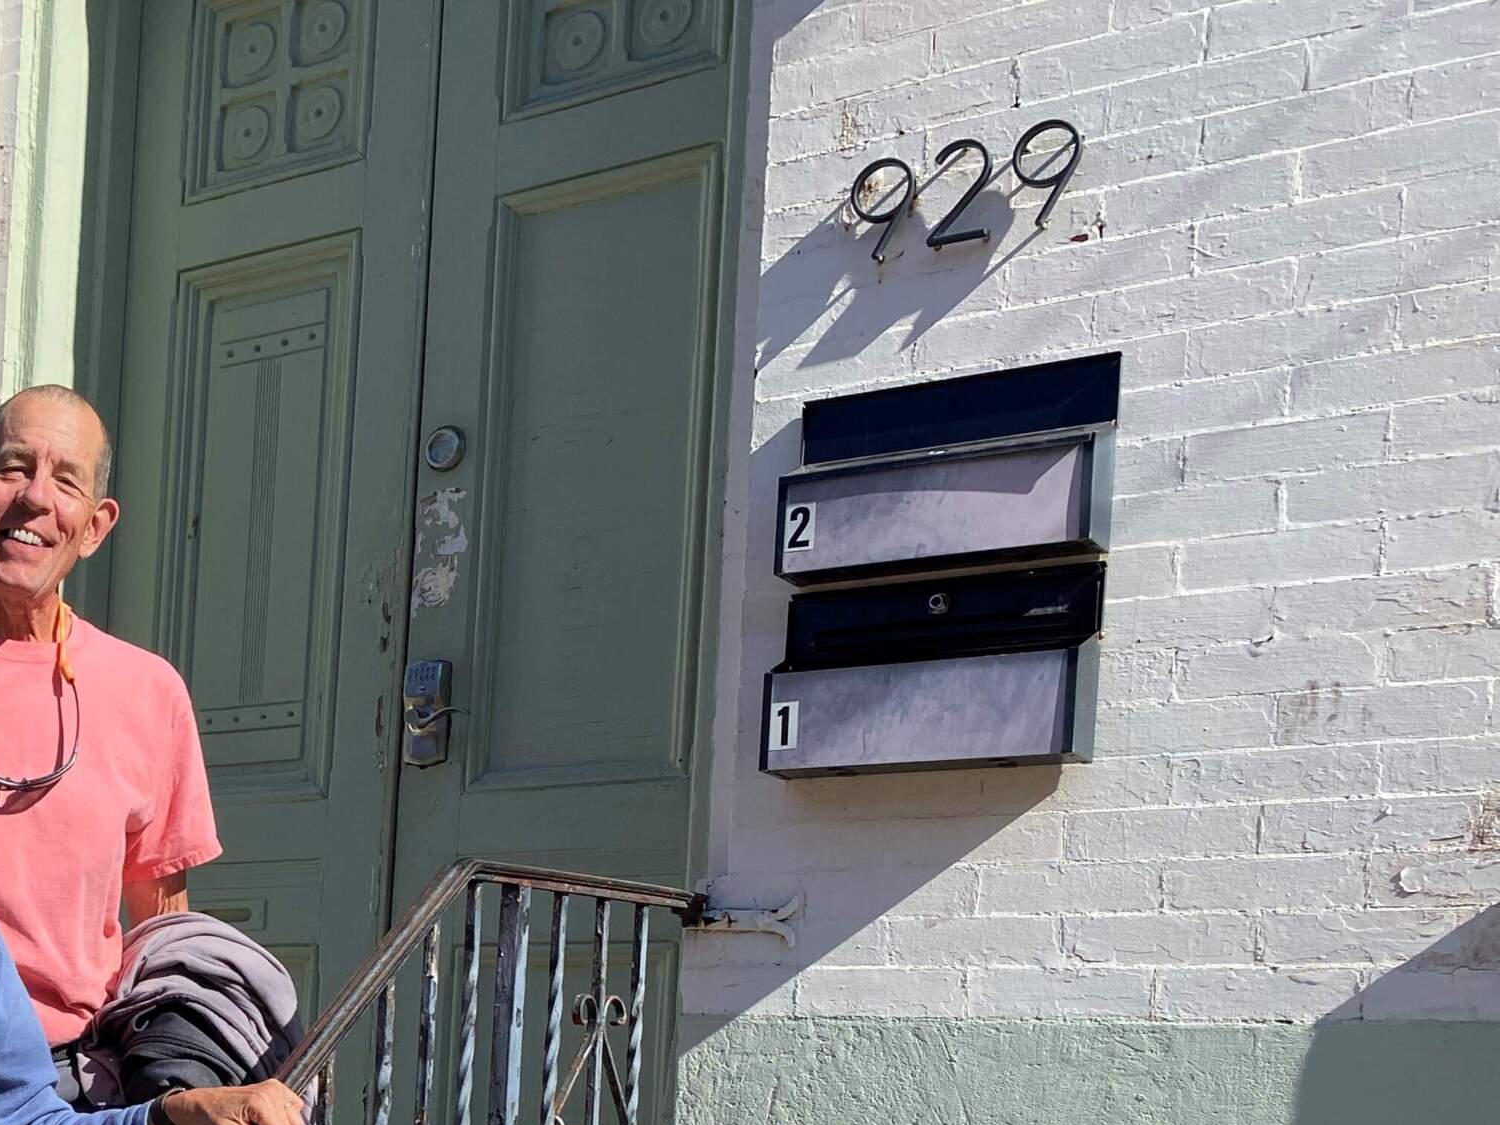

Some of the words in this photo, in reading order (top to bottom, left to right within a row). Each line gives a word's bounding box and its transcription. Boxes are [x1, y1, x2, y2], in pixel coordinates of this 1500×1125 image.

[851, 119, 1083, 261] 929
[788, 506, 811, 549] 2
[777, 705, 790, 746] 1
